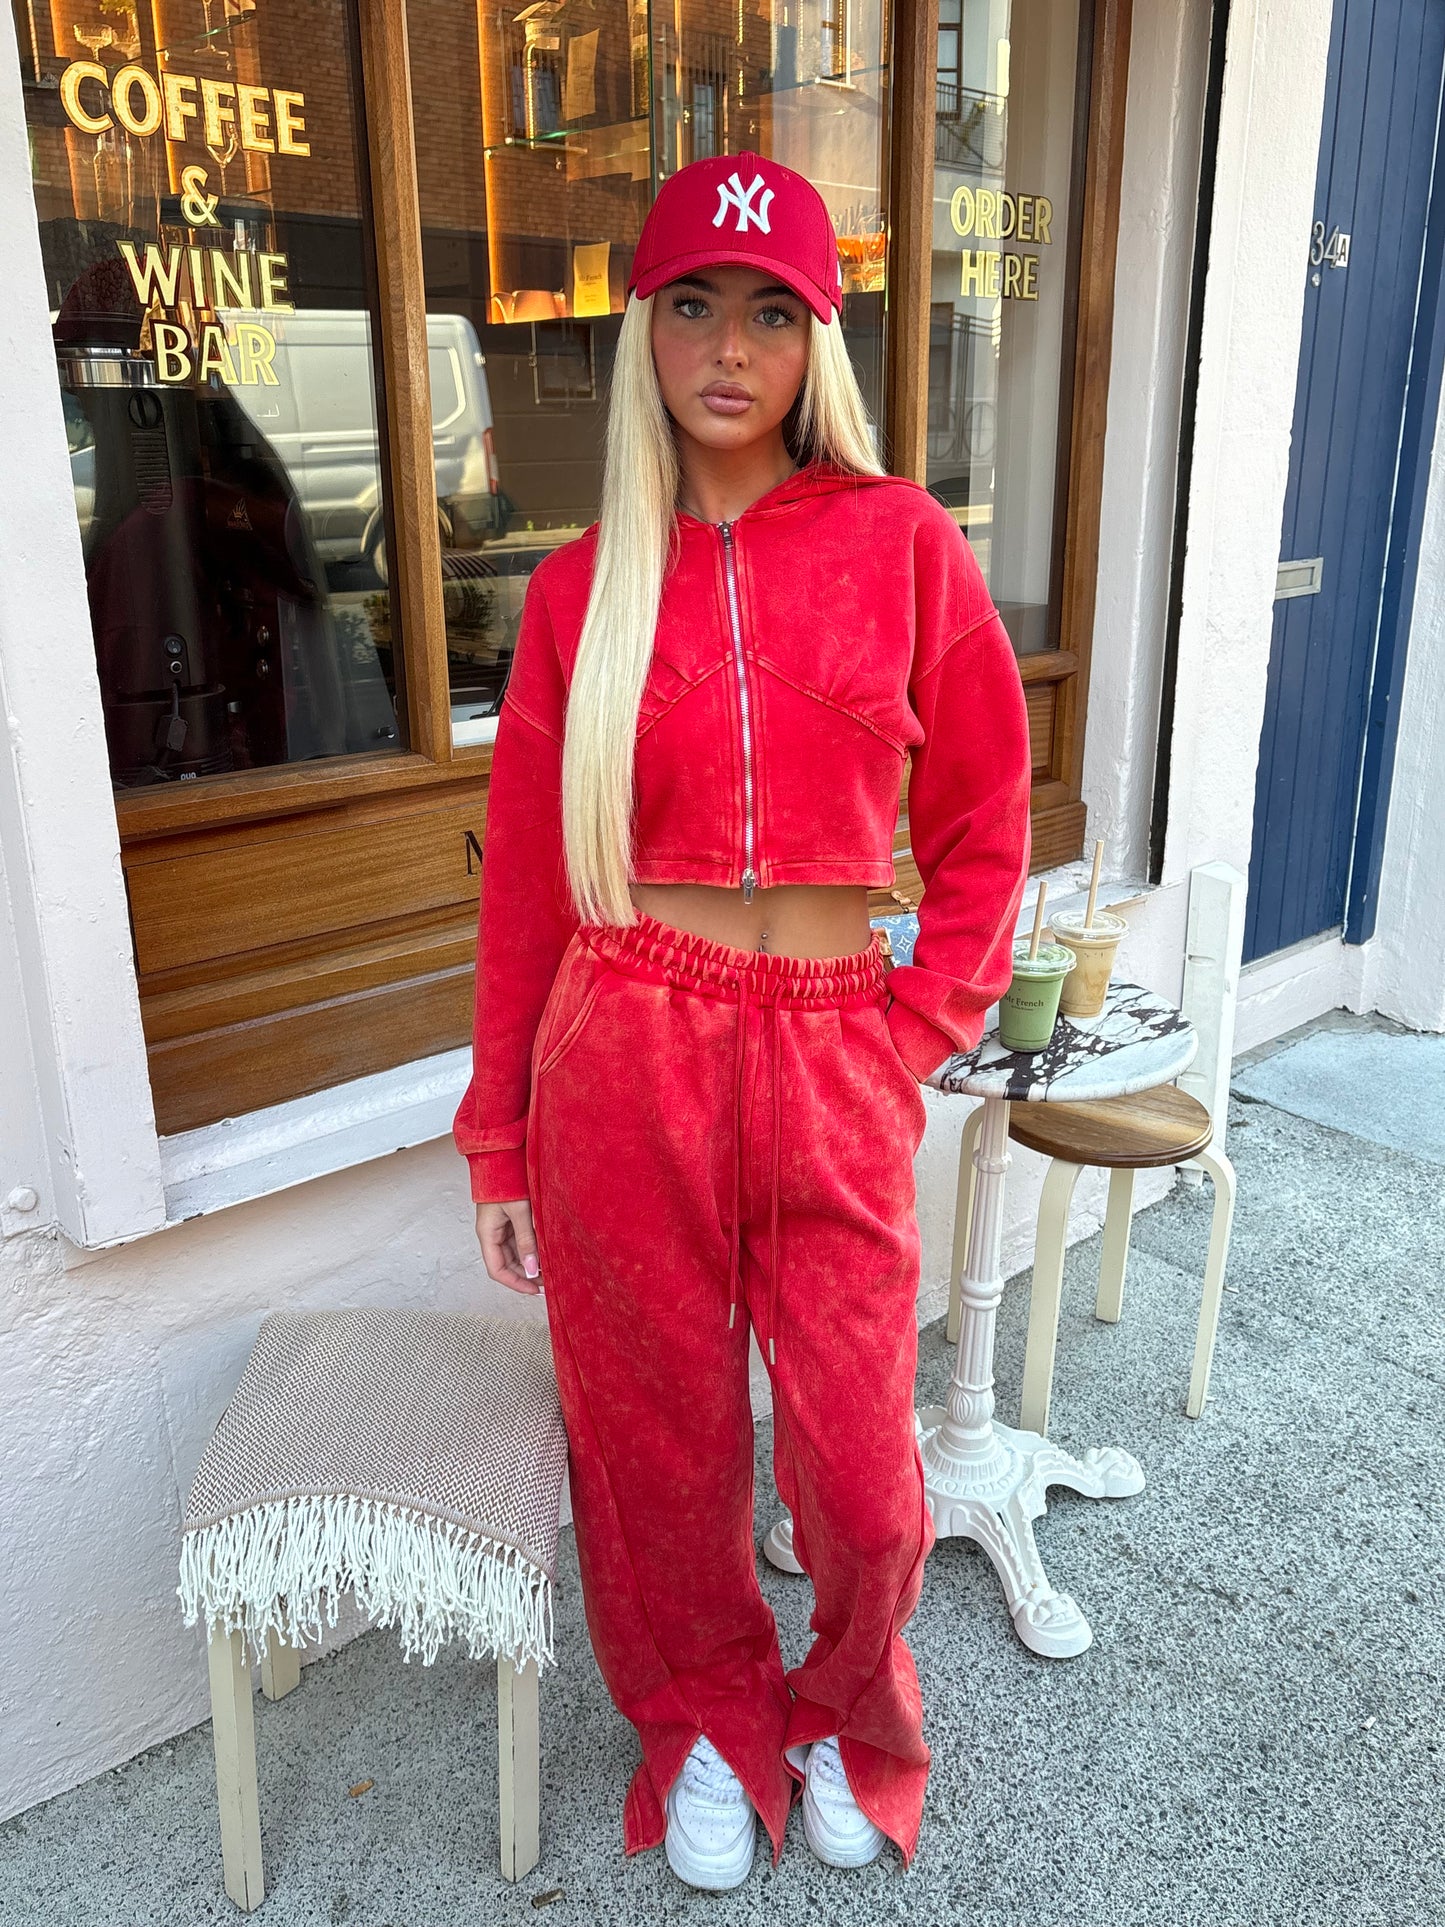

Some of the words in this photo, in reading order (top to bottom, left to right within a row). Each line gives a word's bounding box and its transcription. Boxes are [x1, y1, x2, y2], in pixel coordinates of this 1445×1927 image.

[60, 60, 311, 157] COFFEE
[181, 165, 221, 227] &
[712, 172, 775, 235] NY
[950, 185, 1053, 245] ORDER
[960, 249, 1039, 301] HERE
[1311, 220, 1347, 268] 34A
[116, 240, 295, 315] WINE
[151, 318, 280, 387] BAR
[1016, 997, 1044, 1007] French
